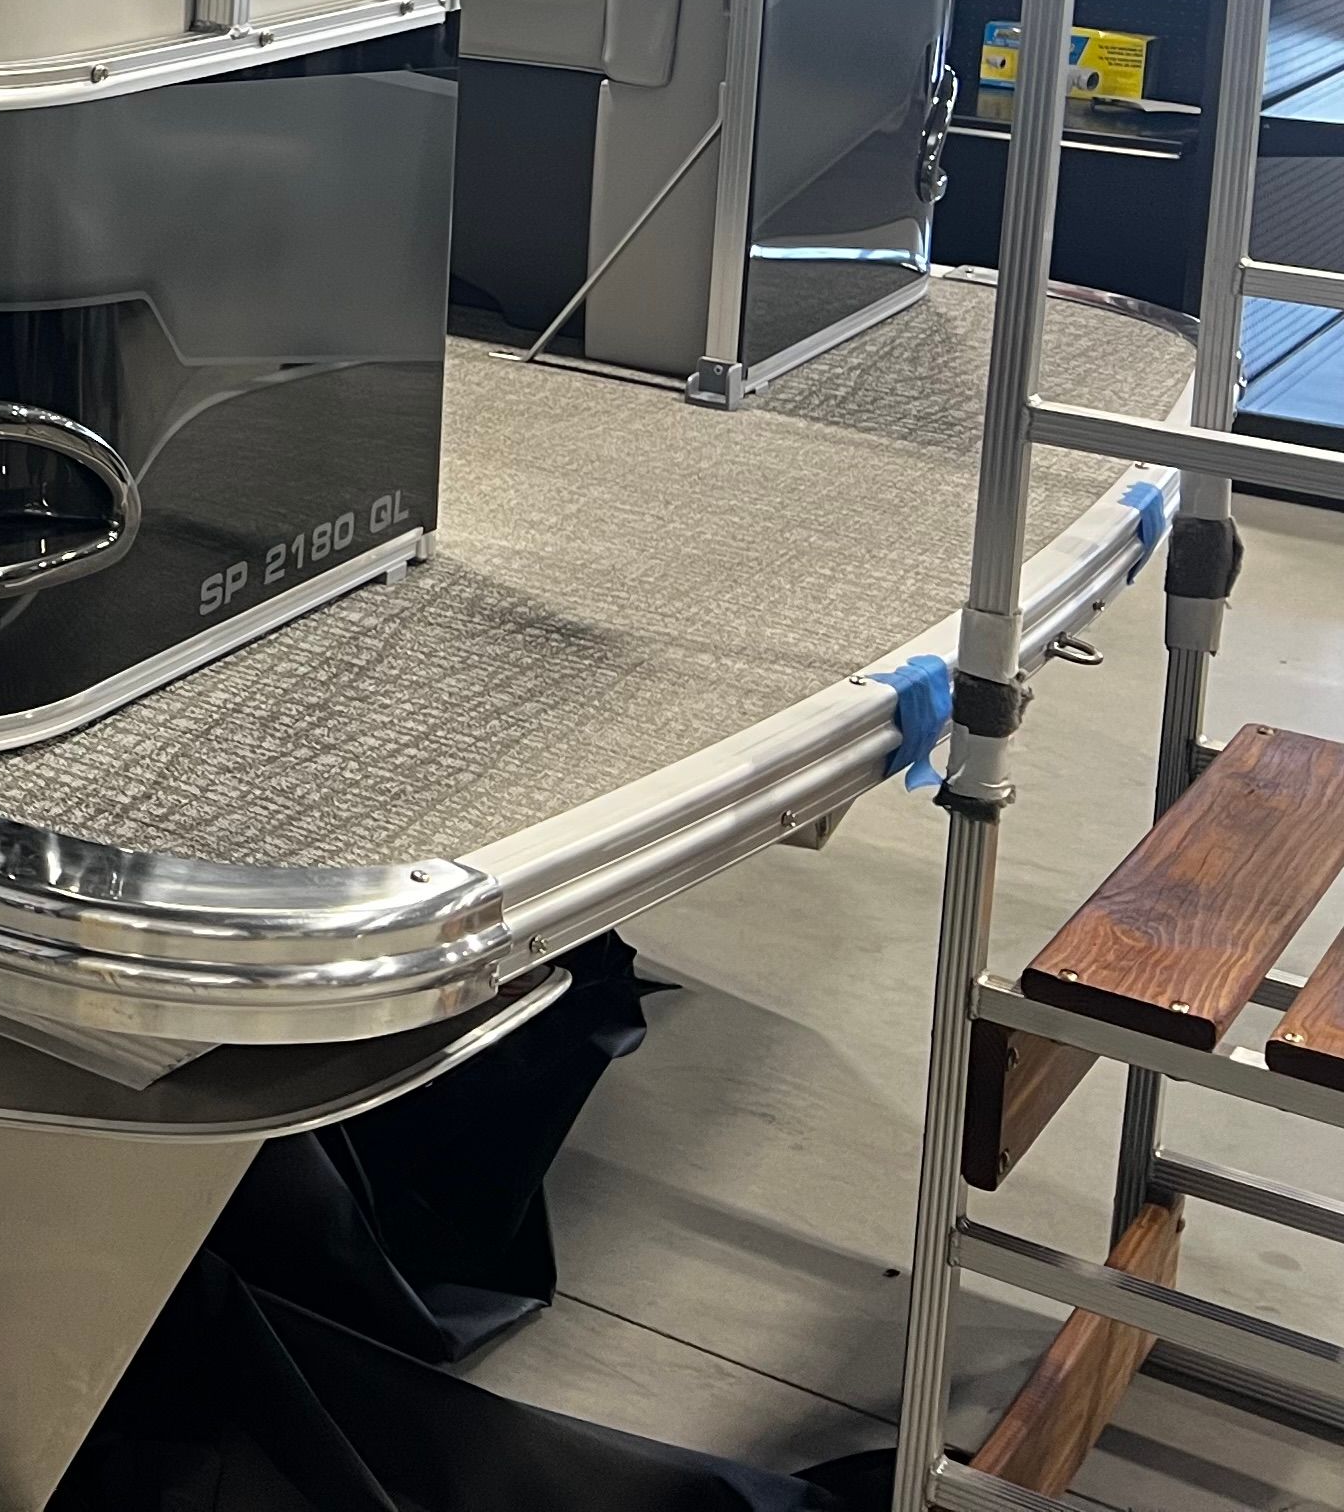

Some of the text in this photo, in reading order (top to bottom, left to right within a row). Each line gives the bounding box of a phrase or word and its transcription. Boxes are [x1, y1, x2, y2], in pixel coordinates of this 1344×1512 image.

[199, 489, 409, 616] SP 2180 QL
